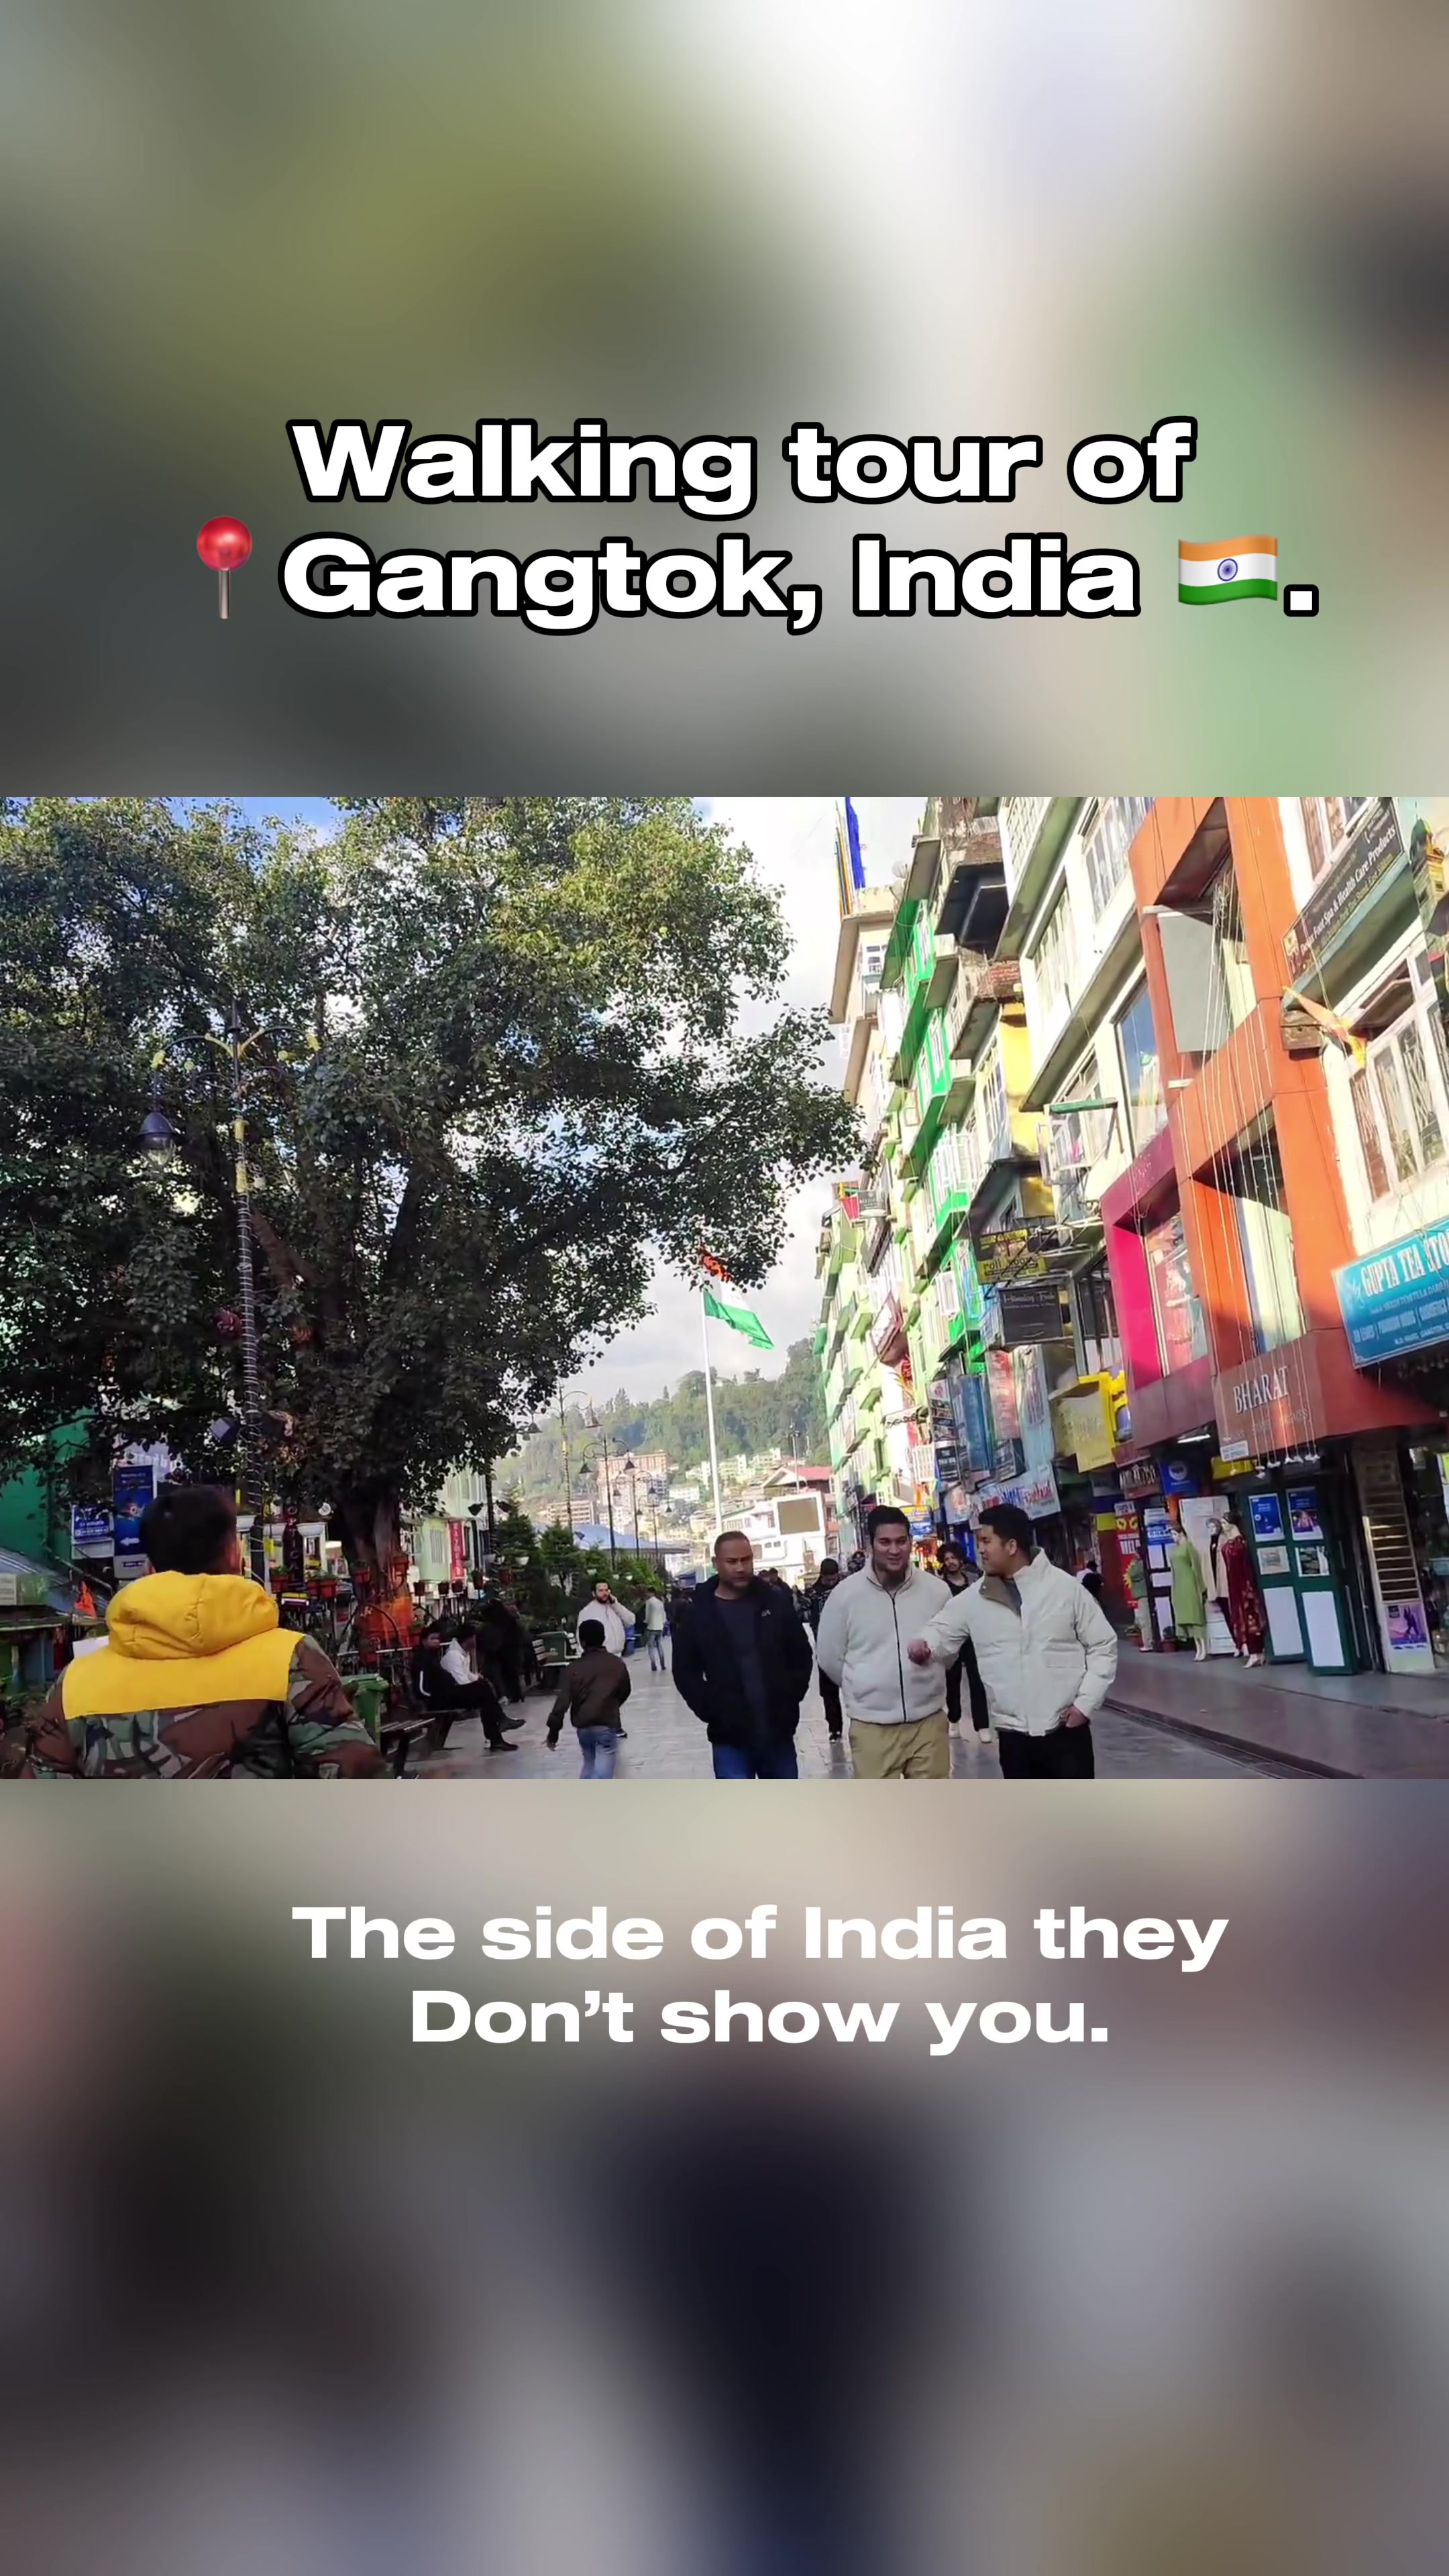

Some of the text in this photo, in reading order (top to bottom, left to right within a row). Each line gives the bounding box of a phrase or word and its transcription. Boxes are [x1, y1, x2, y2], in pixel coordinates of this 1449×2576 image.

[1324, 907, 1335, 925] Spa
[1337, 878, 1356, 906] Health
[1355, 862, 1369, 882] Care
[1367, 825, 1396, 865] Products
[1360, 1254, 1400, 1297] GUPTA
[1397, 1243, 1427, 1283] TEA
[1233, 1366, 1289, 1414] BHARAT
